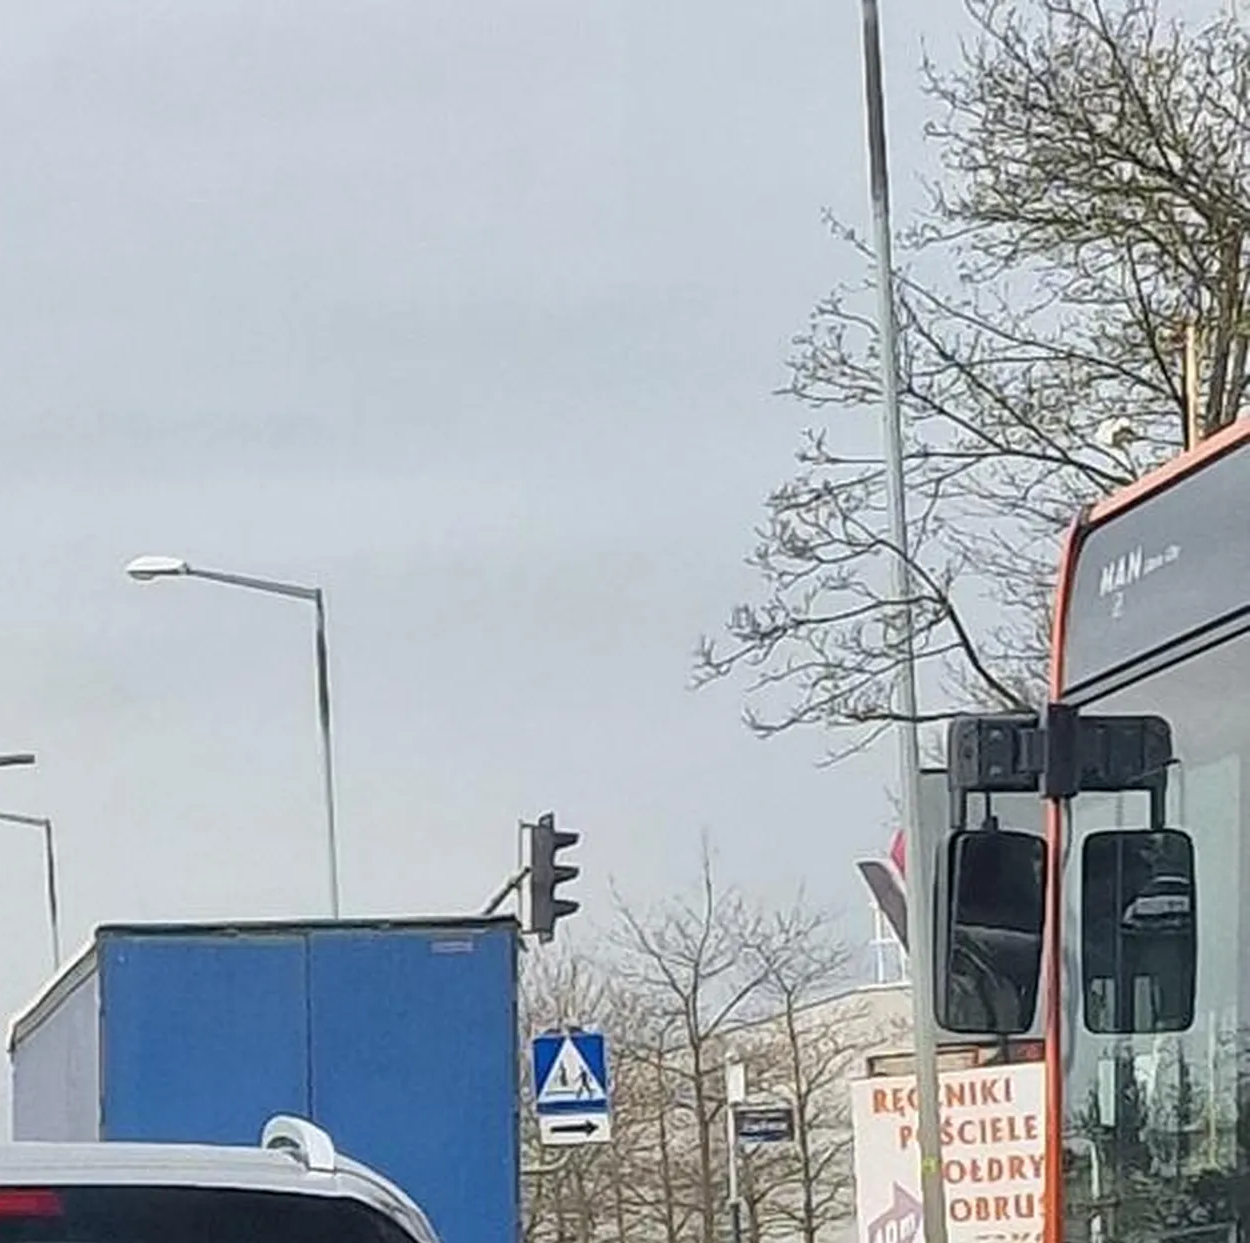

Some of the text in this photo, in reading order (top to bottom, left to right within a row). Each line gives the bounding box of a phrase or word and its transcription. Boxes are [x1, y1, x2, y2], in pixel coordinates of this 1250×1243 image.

[1100, 545, 1142, 597] MAN
[872, 1077, 1013, 1117] RĘCNIKI
[900, 1115, 1039, 1150] PŚCIELE
[944, 1154, 1045, 1185] OŁDRY
[950, 1193, 1045, 1223] OBRU
